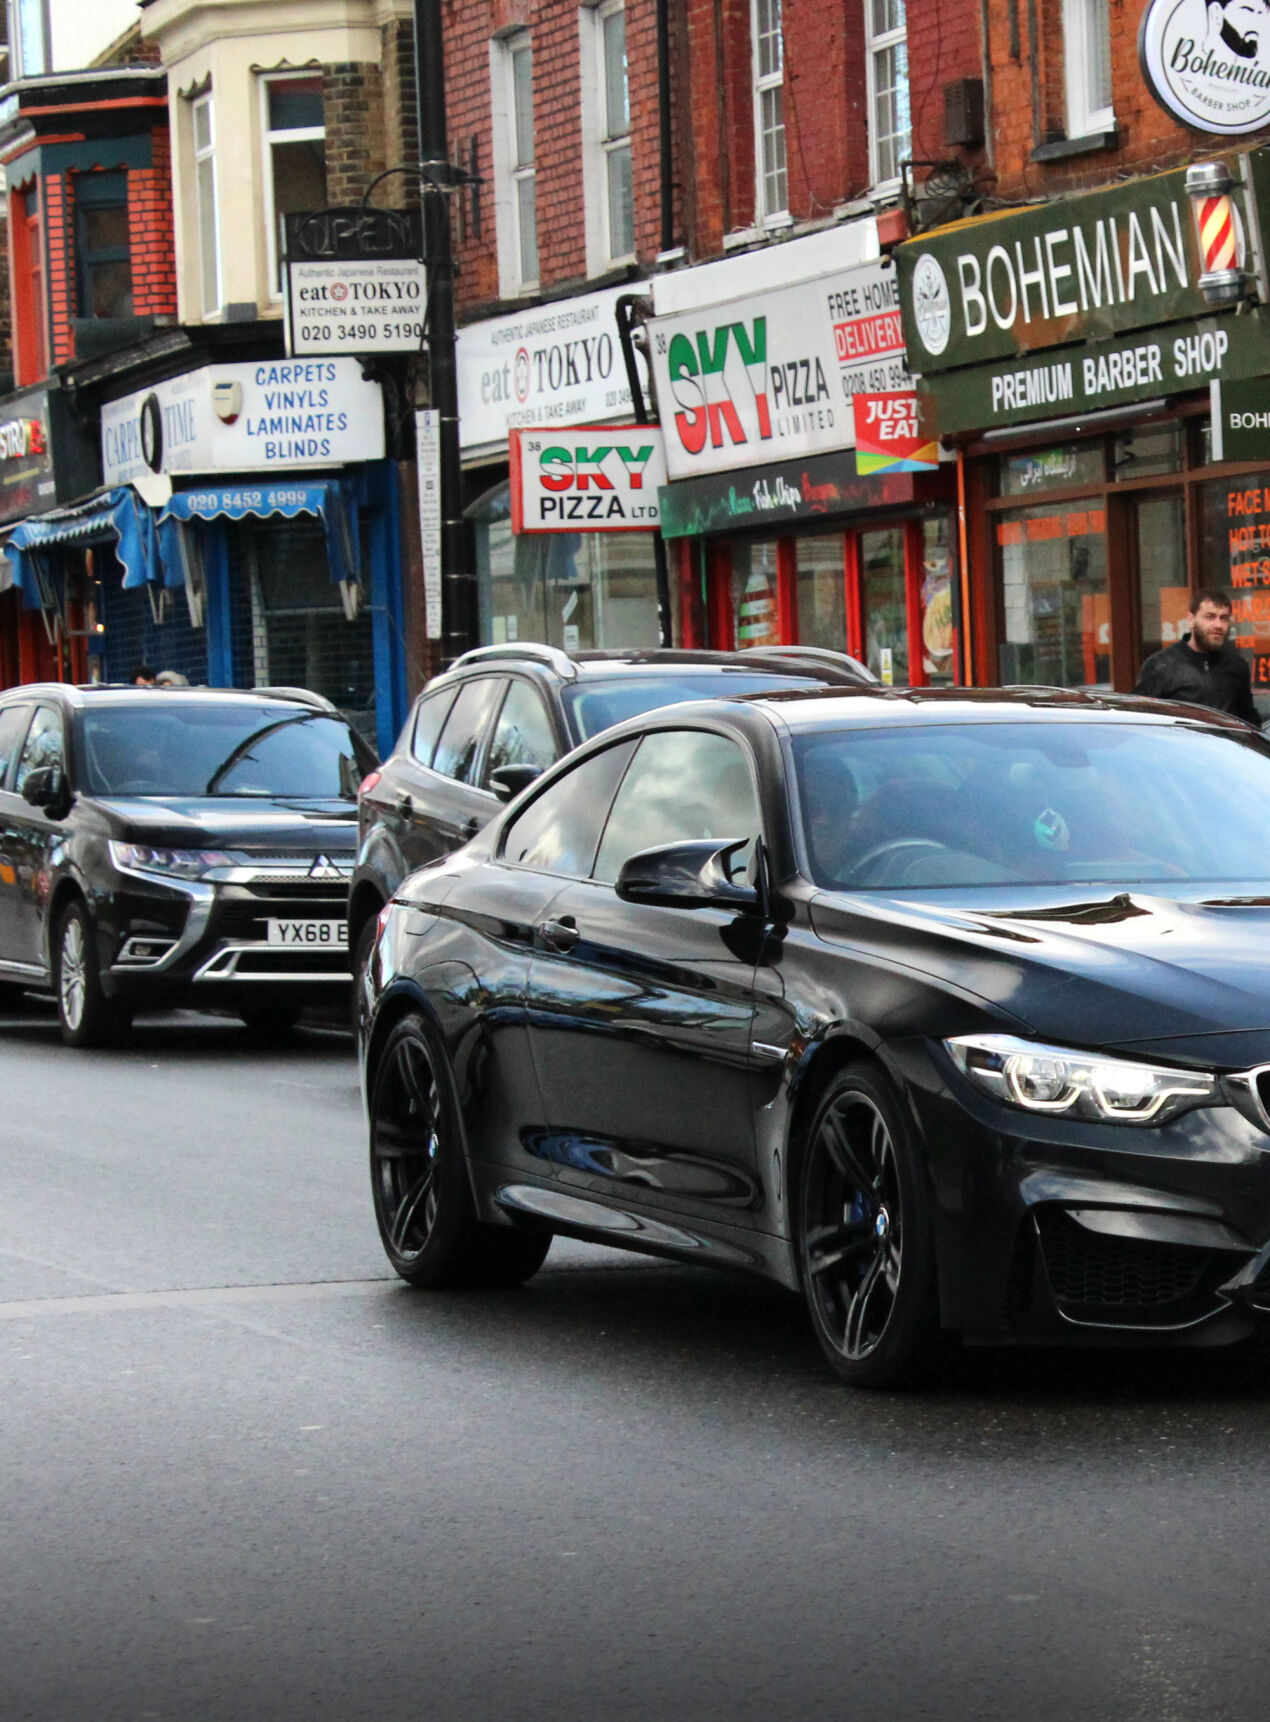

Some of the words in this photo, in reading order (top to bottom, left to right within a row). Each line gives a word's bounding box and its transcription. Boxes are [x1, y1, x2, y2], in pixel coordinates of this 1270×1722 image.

[1191, 87, 1223, 110] BARBER
[1227, 99, 1250, 111] SHOP
[957, 201, 1189, 337] BOHEMIAN
[300, 285, 328, 301] eat
[349, 281, 420, 300] TOKYO
[828, 288, 861, 320] FREE
[862, 280, 900, 311] HOME
[300, 307, 347, 317] KITCHEN
[350, 306, 357, 316] &
[361, 306, 388, 315] TAKE
[391, 305, 420, 315] AWAY
[302, 325, 331, 341] 020
[338, 323, 377, 340] 3490
[383, 322, 421, 340] 5190
[656, 333, 667, 355] 38
[834, 313, 904, 357] DELIVERY
[255, 363, 336, 386] CARPETS
[481, 361, 511, 403] eat
[533, 333, 613, 393] TOKYO
[992, 363, 1073, 412] PREMIUM
[1083, 344, 1163, 395] BARBER
[1174, 330, 1228, 377] SHOP
[669, 316, 772, 455] SKY
[770, 356, 830, 409] PIZZA
[842, 373, 866, 398] 0208
[869, 367, 886, 391] 450
[265, 389, 328, 410] VINYLS
[545, 402, 564, 419] TAKE
[565, 398, 587, 413] AWAY
[866, 399, 917, 424] JUST
[247, 412, 347, 436] LAMINATES
[778, 408, 834, 437] LIMITED
[879, 420, 918, 440] EAT
[105, 417, 142, 468] CARPE
[265, 438, 330, 459] BLINDS
[528, 442, 541, 452] 38
[539, 446, 654, 492] SKY
[187, 494, 217, 511] 020
[222, 491, 262, 509] 8452
[268, 491, 306, 507] 4999
[540, 495, 626, 520] PIZZA
[632, 506, 658, 518] LTD
[1228, 489, 1261, 517] FACE
[1230, 526, 1256, 553] HOT
[1231, 562, 1259, 588] WET
[278, 923, 331, 942] YX68
